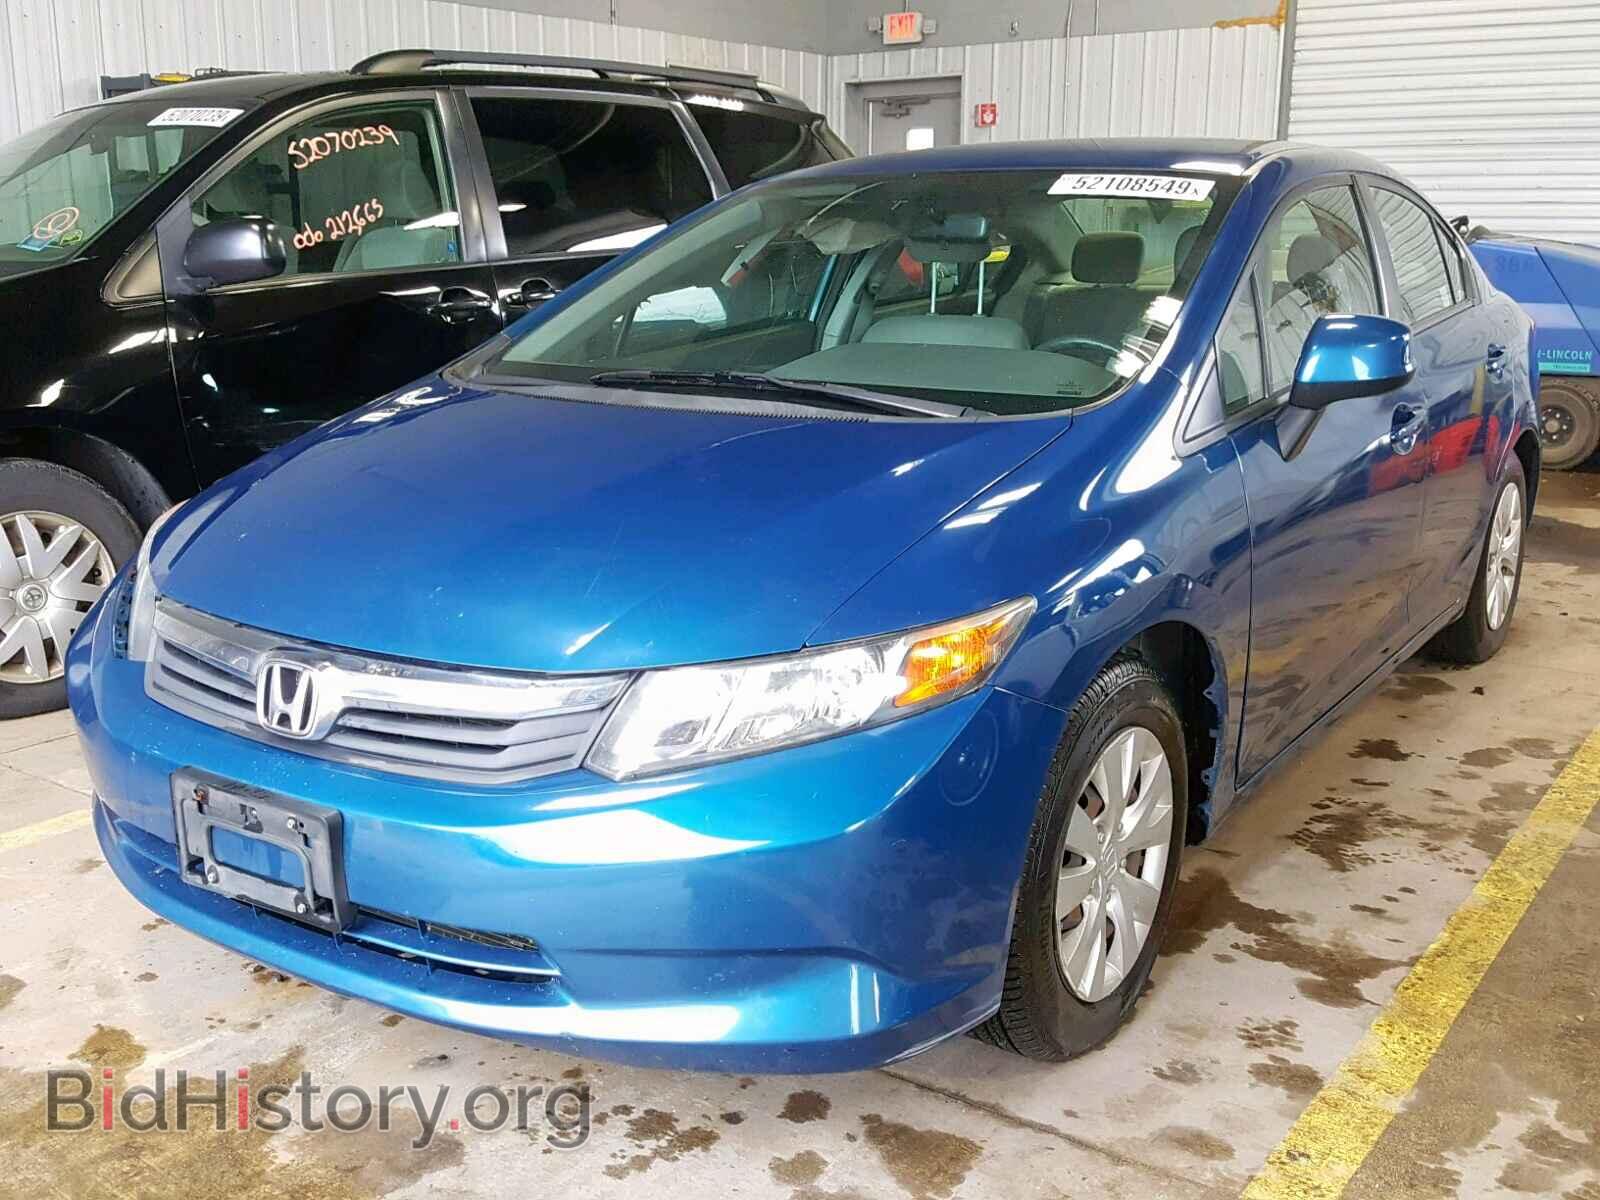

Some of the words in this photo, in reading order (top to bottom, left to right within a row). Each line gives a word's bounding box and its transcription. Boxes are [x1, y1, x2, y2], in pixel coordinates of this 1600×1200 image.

[889, 14, 915, 36] EXIT
[288, 125, 400, 169] 52070239
[1072, 176, 1191, 195] 52108549
